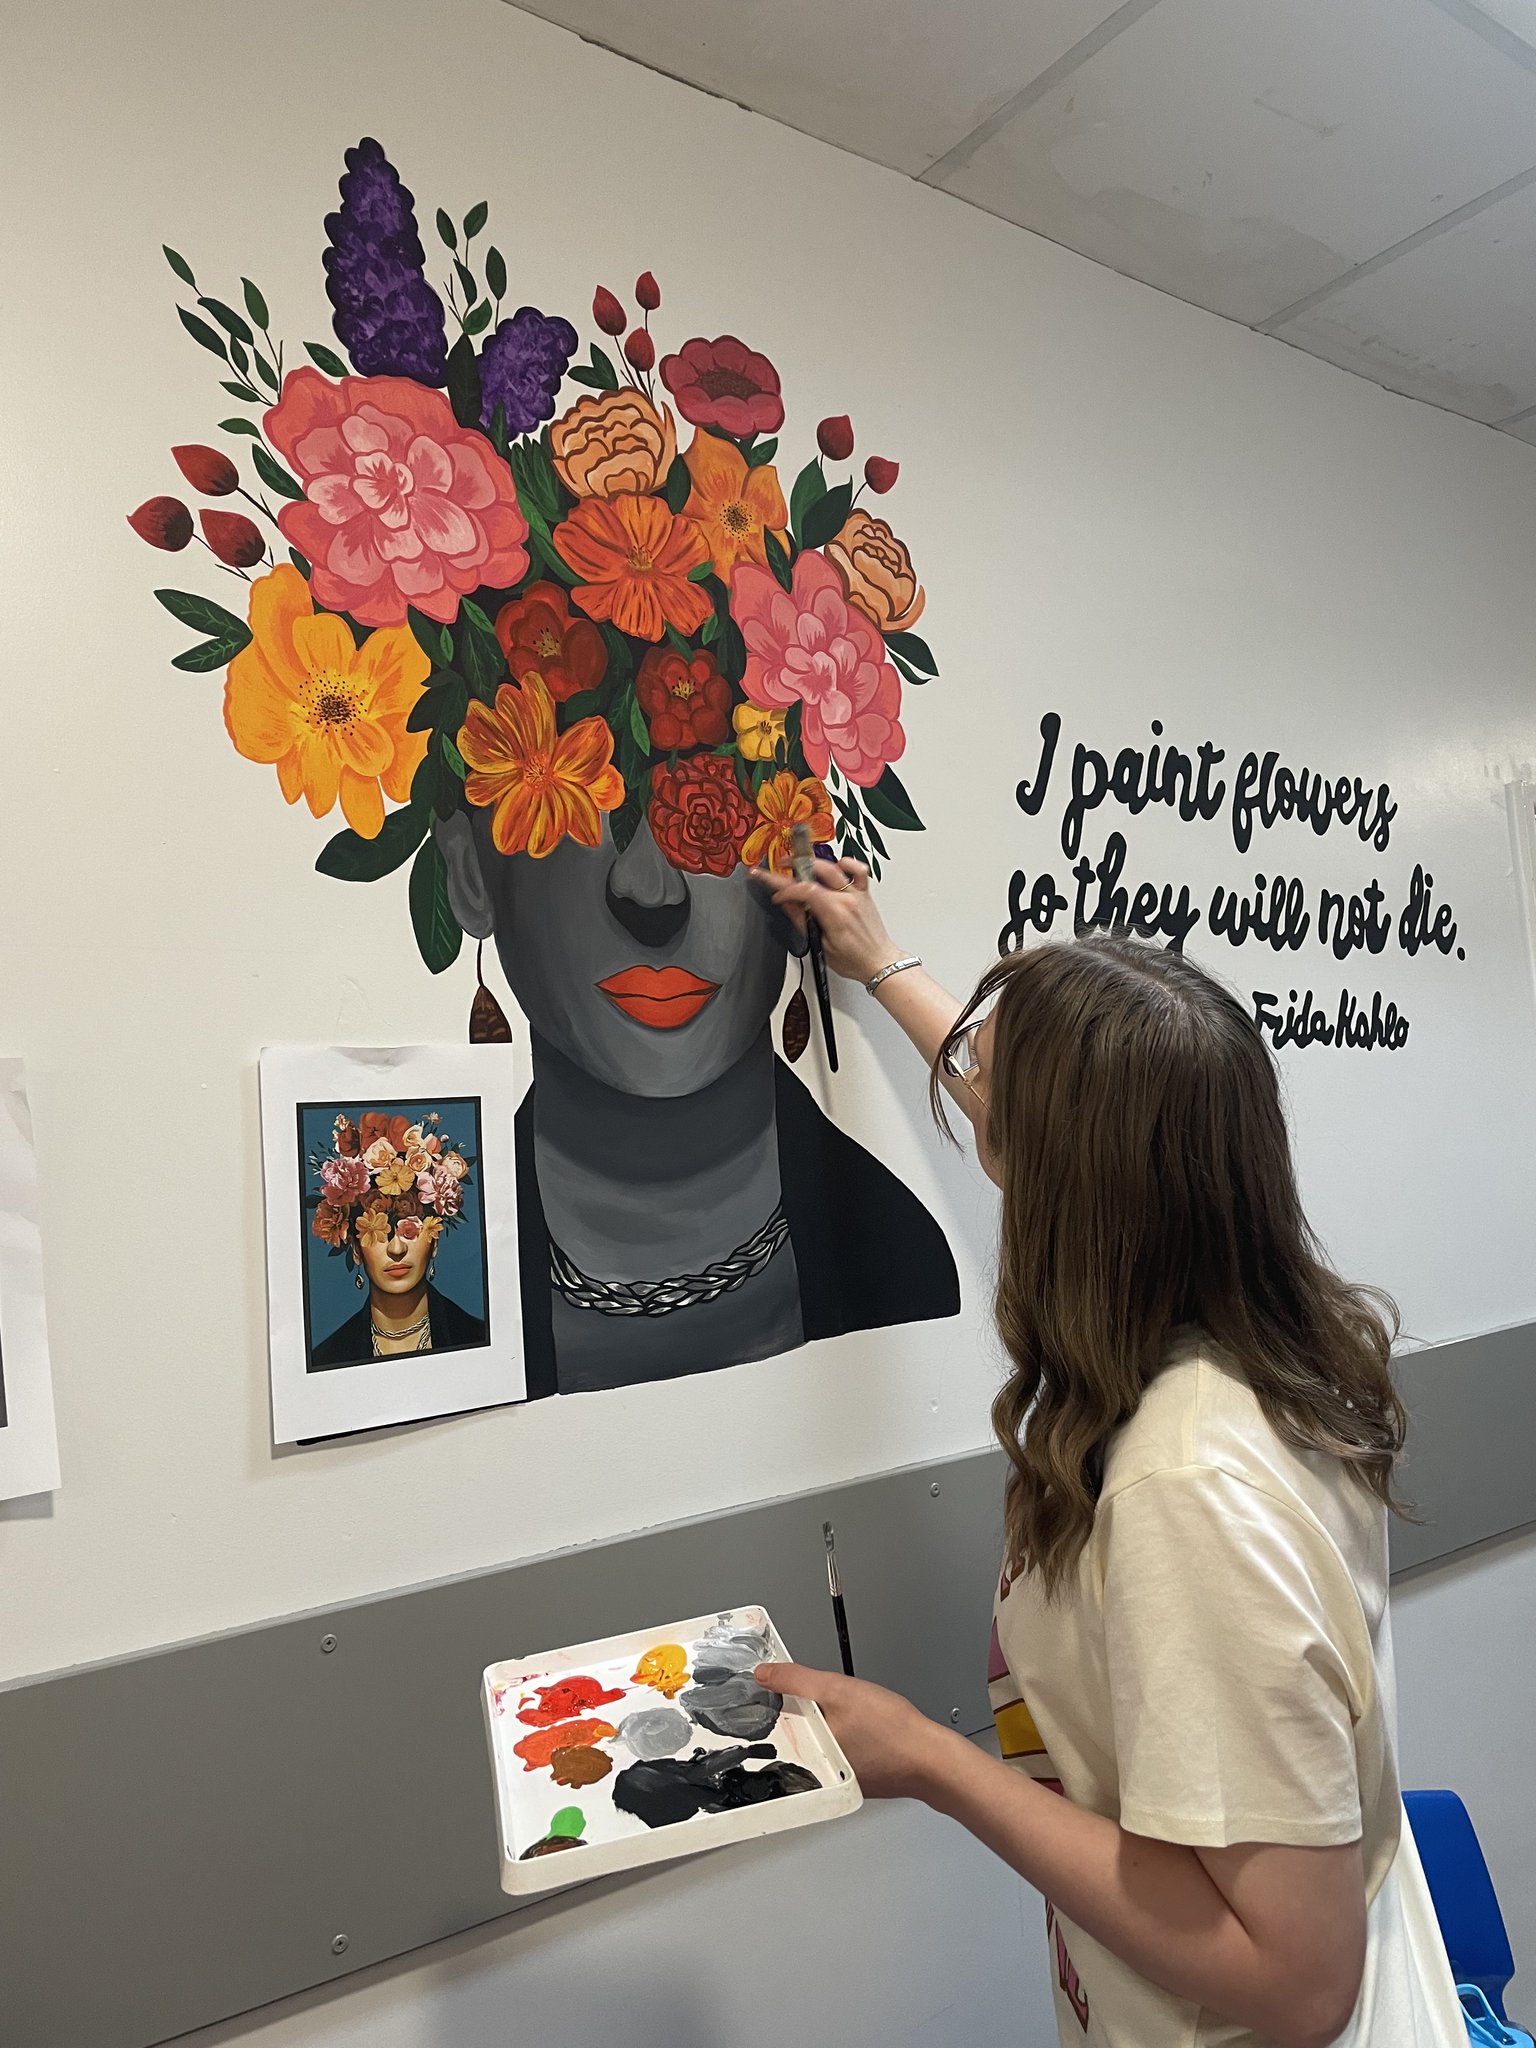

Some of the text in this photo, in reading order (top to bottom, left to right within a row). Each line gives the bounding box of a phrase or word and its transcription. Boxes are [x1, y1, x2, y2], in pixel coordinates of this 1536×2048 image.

[1015, 712, 1398, 861] I paint flowers
[998, 831, 1467, 962] so they will not die.
[1251, 988, 1410, 1052] Frida Kahlo
